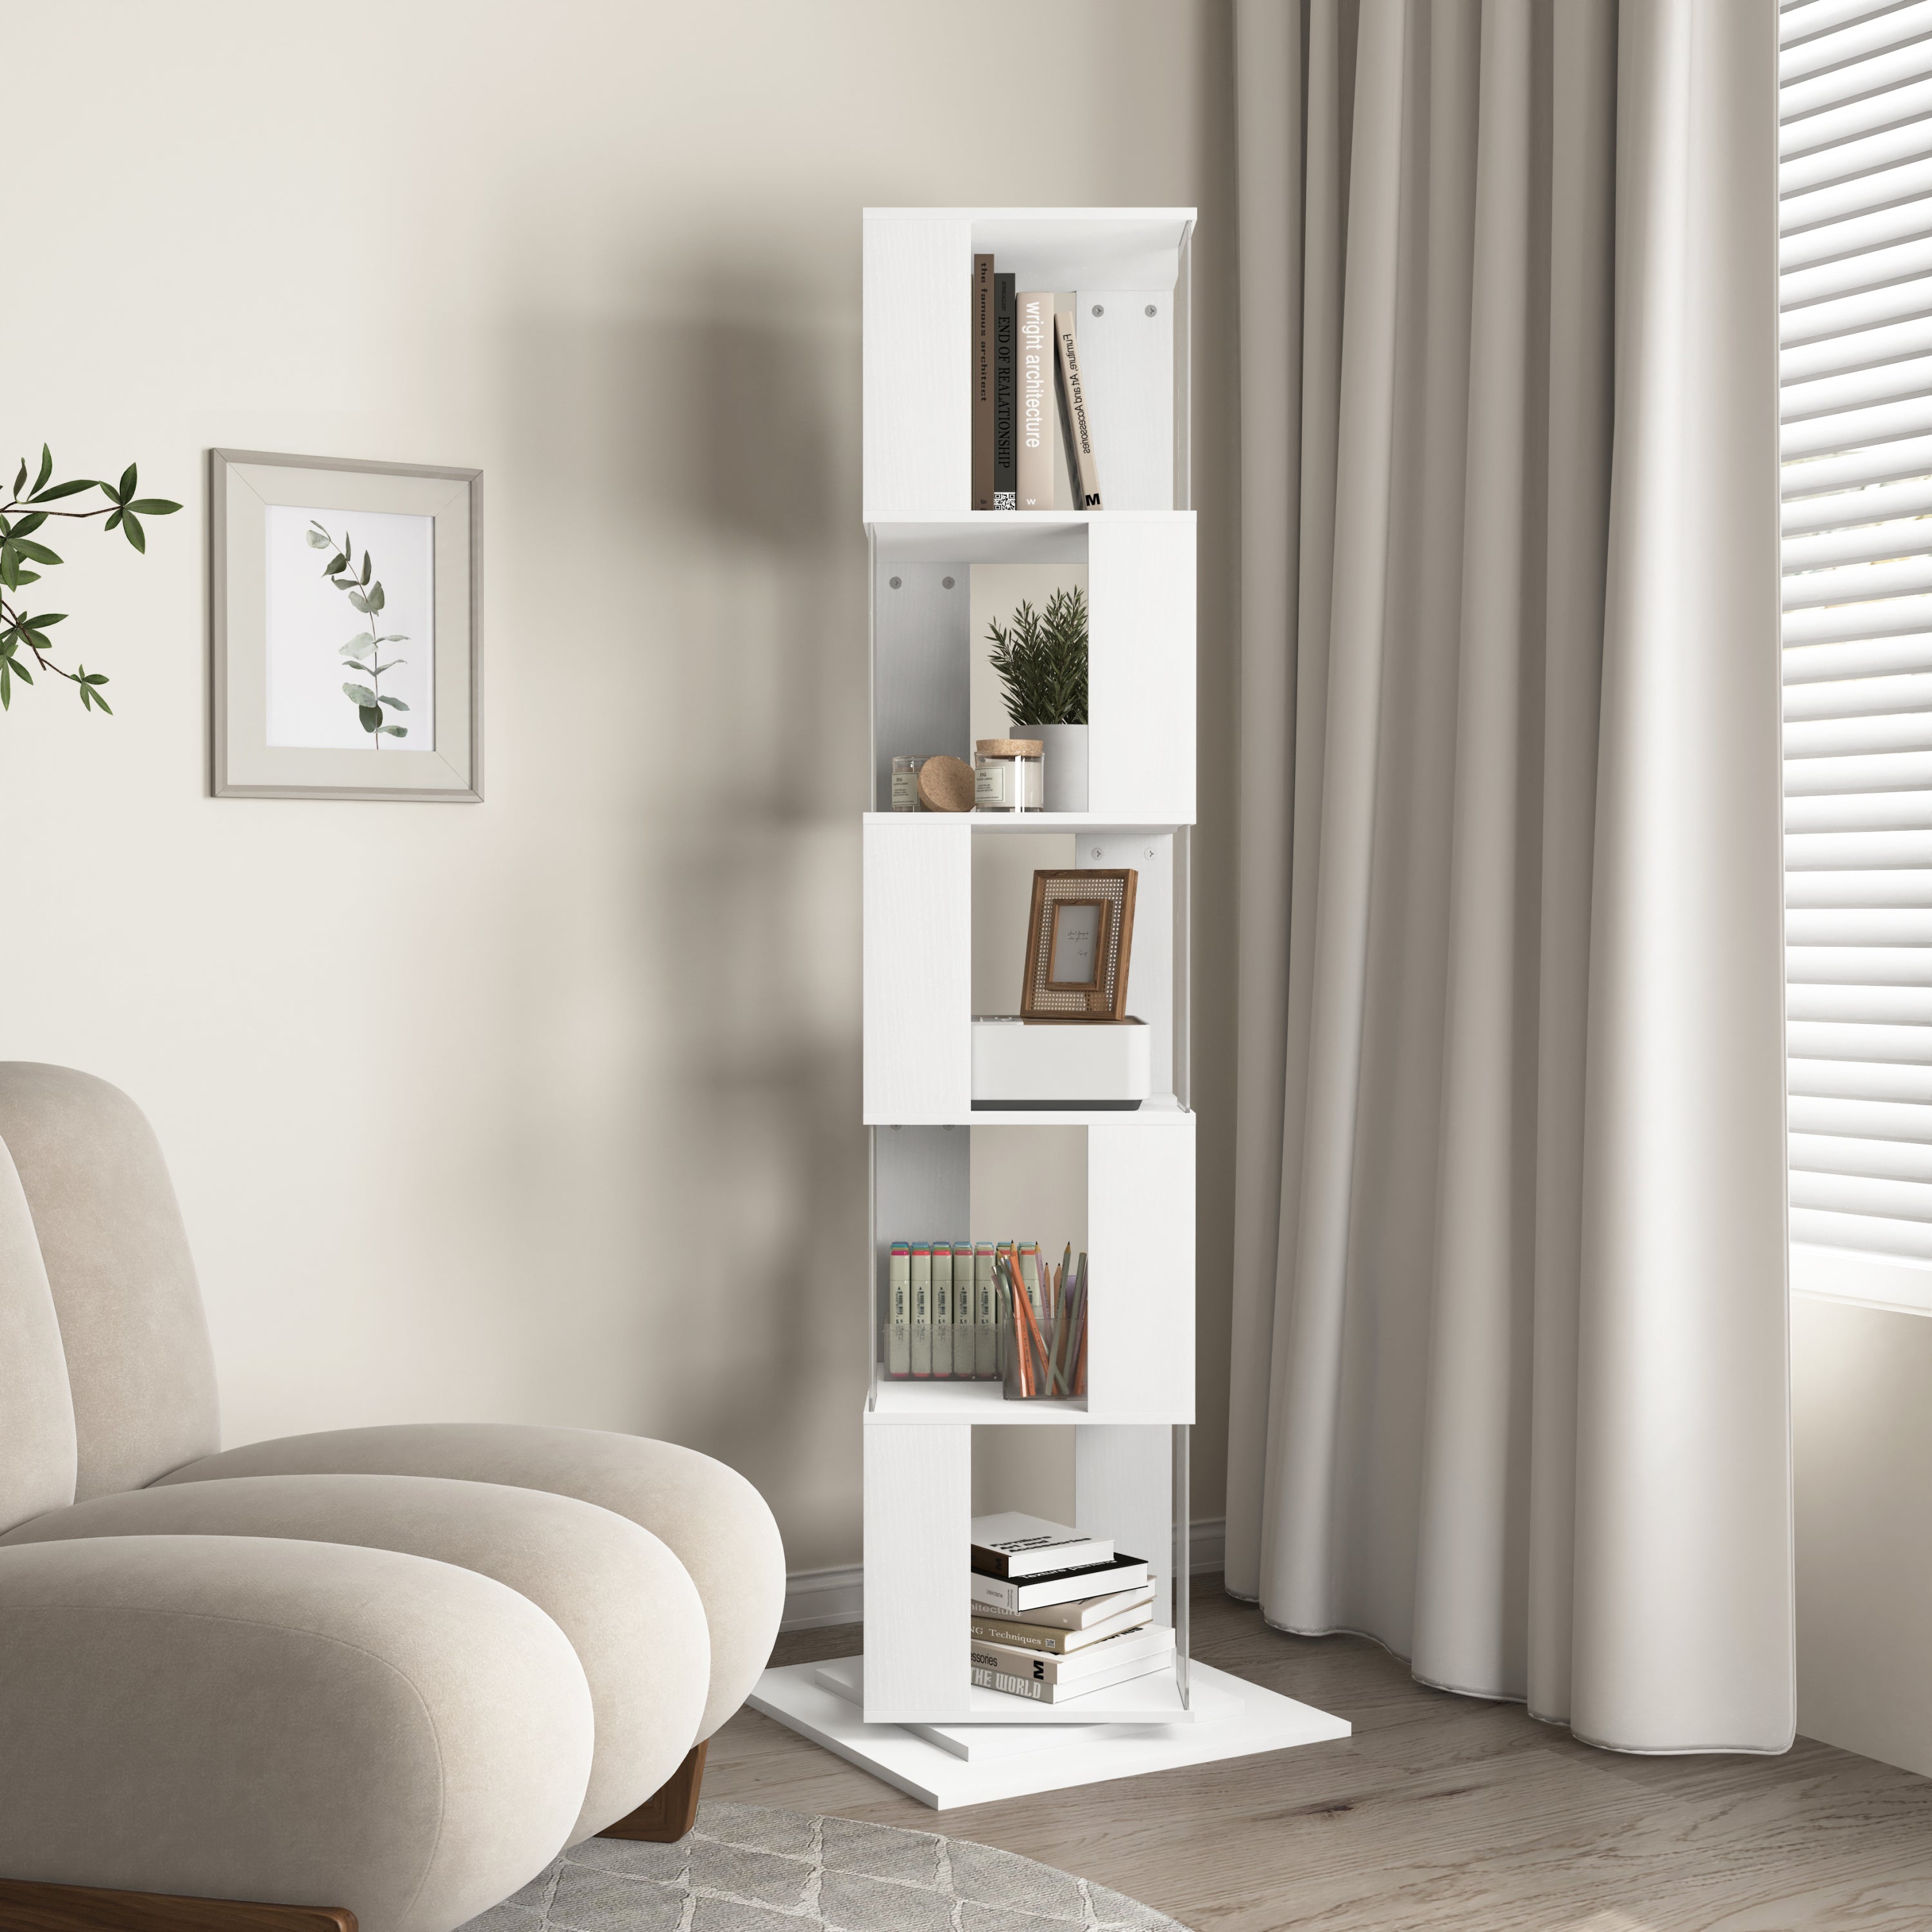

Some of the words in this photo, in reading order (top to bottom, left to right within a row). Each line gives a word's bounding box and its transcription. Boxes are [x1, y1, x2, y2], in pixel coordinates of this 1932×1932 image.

[998, 316, 1010, 343] END
[1022, 301, 1044, 350] wright
[998, 346, 1010, 363] OF
[1026, 355, 1044, 448] architecture
[998, 367, 1010, 468] REALATIONSHIP
[1085, 493, 1101, 507] M
[989, 1536, 1052, 1547] Furniture
[989, 1628, 1041, 1645] Techniques
[1034, 1660, 1044, 1680] M
[996, 1672, 1041, 1699] WORLD
